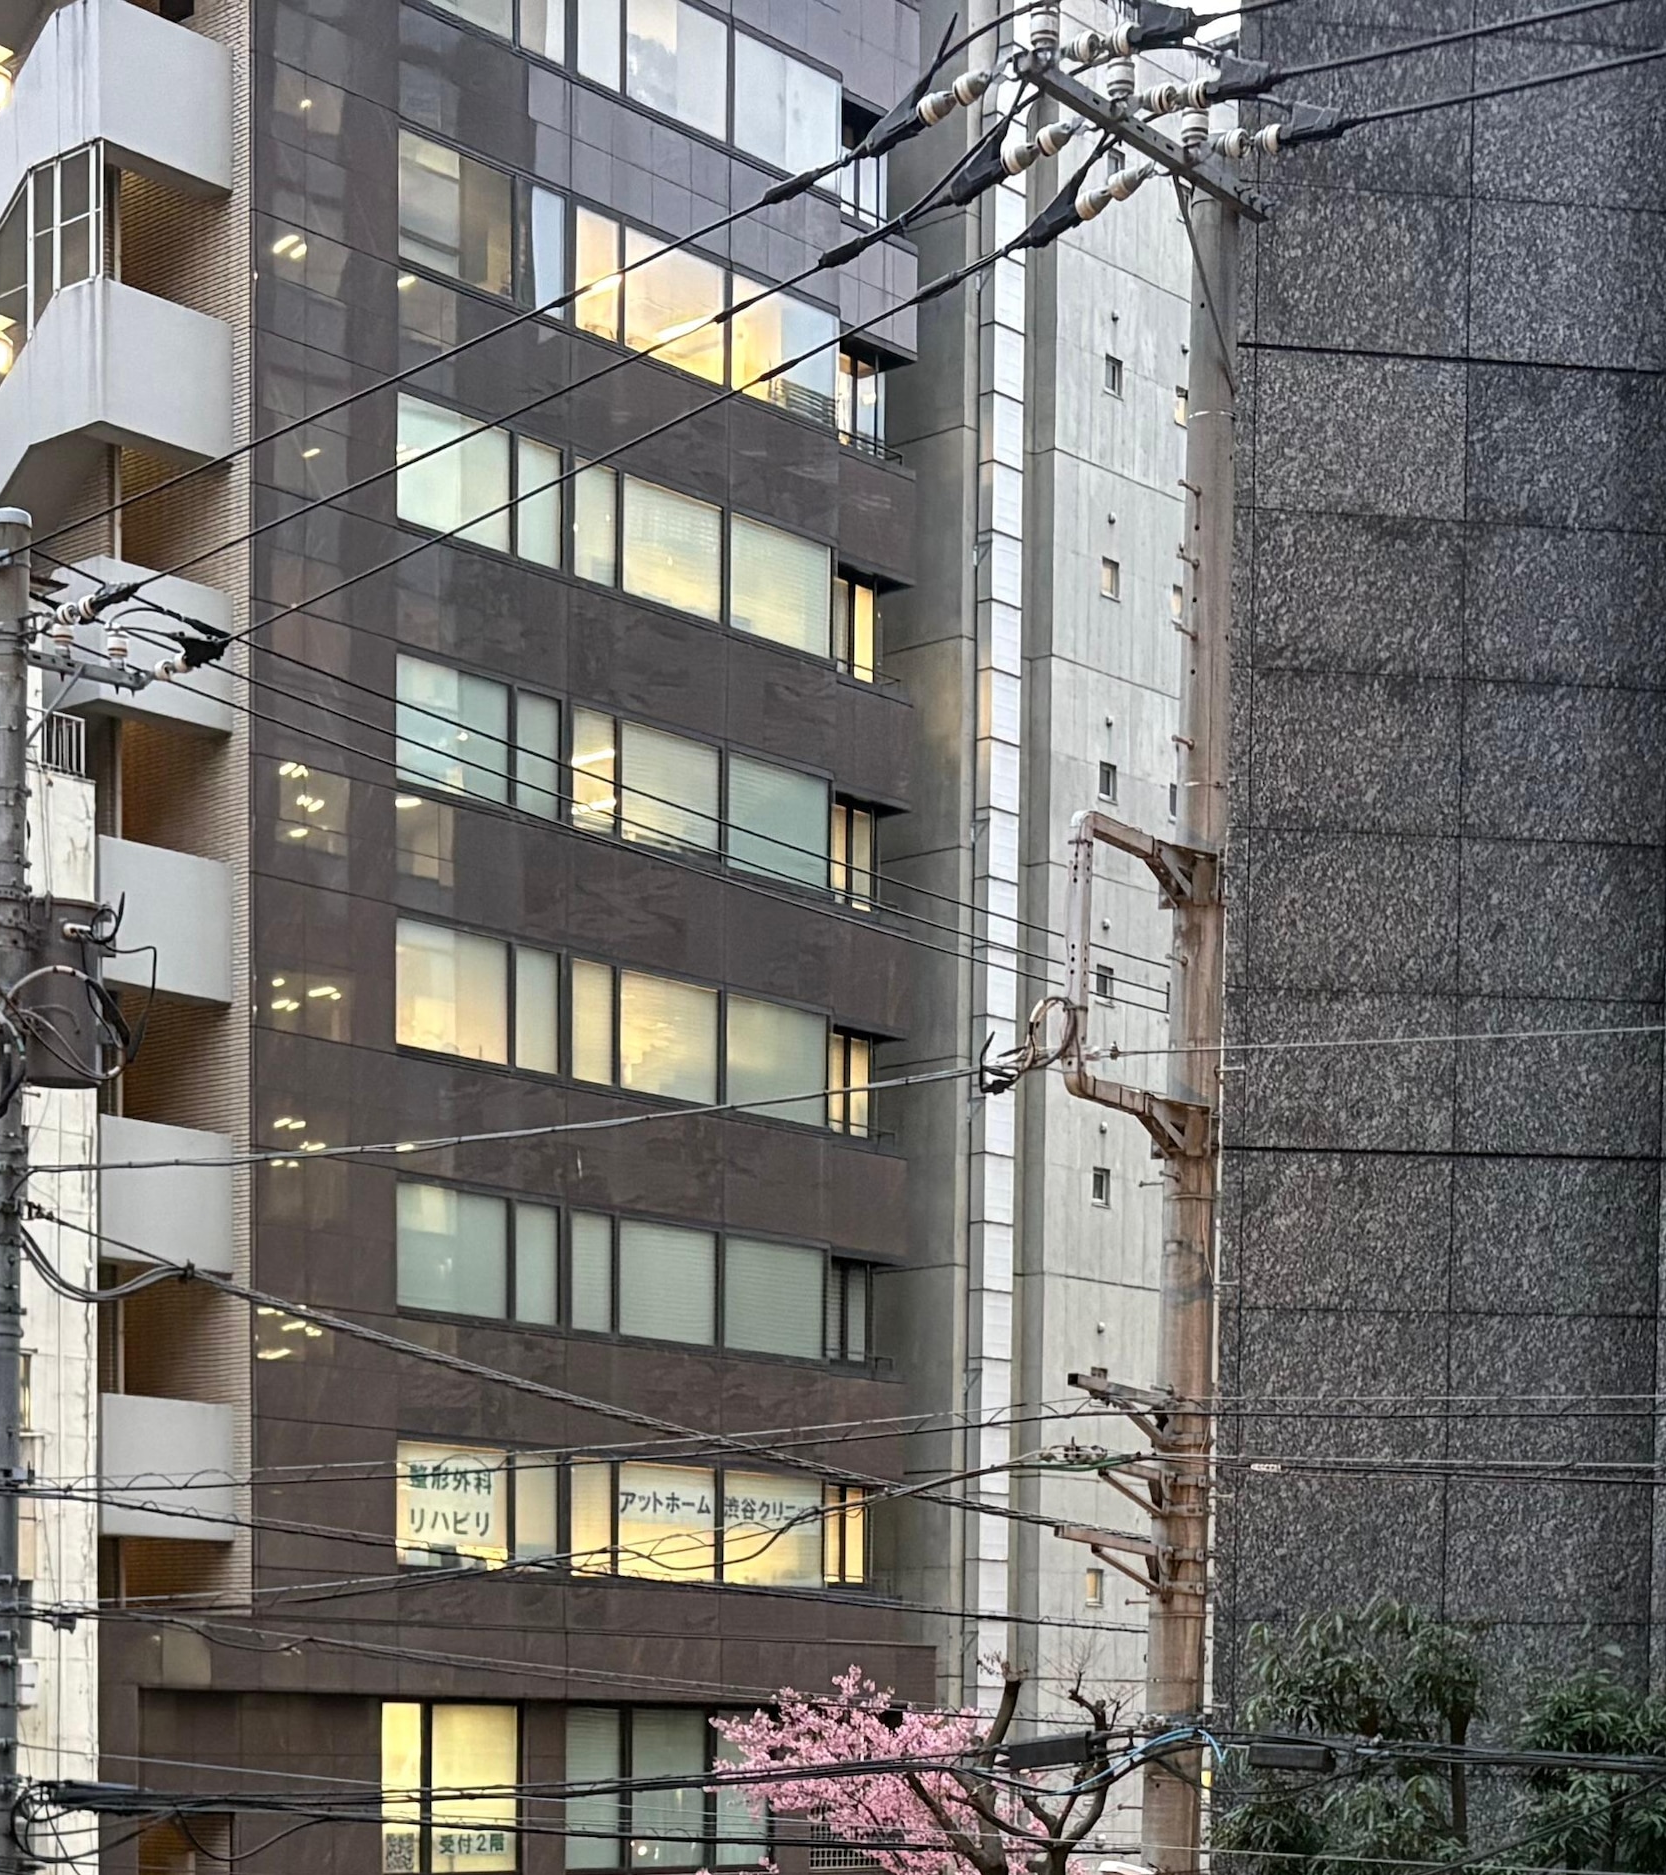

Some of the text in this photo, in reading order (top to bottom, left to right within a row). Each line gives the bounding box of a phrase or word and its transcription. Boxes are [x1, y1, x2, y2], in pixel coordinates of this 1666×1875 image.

[620, 1491, 711, 1515] アットホーム
[410, 1508, 490, 1537] リハビリ
[438, 1833, 505, 1855] 受付2階
